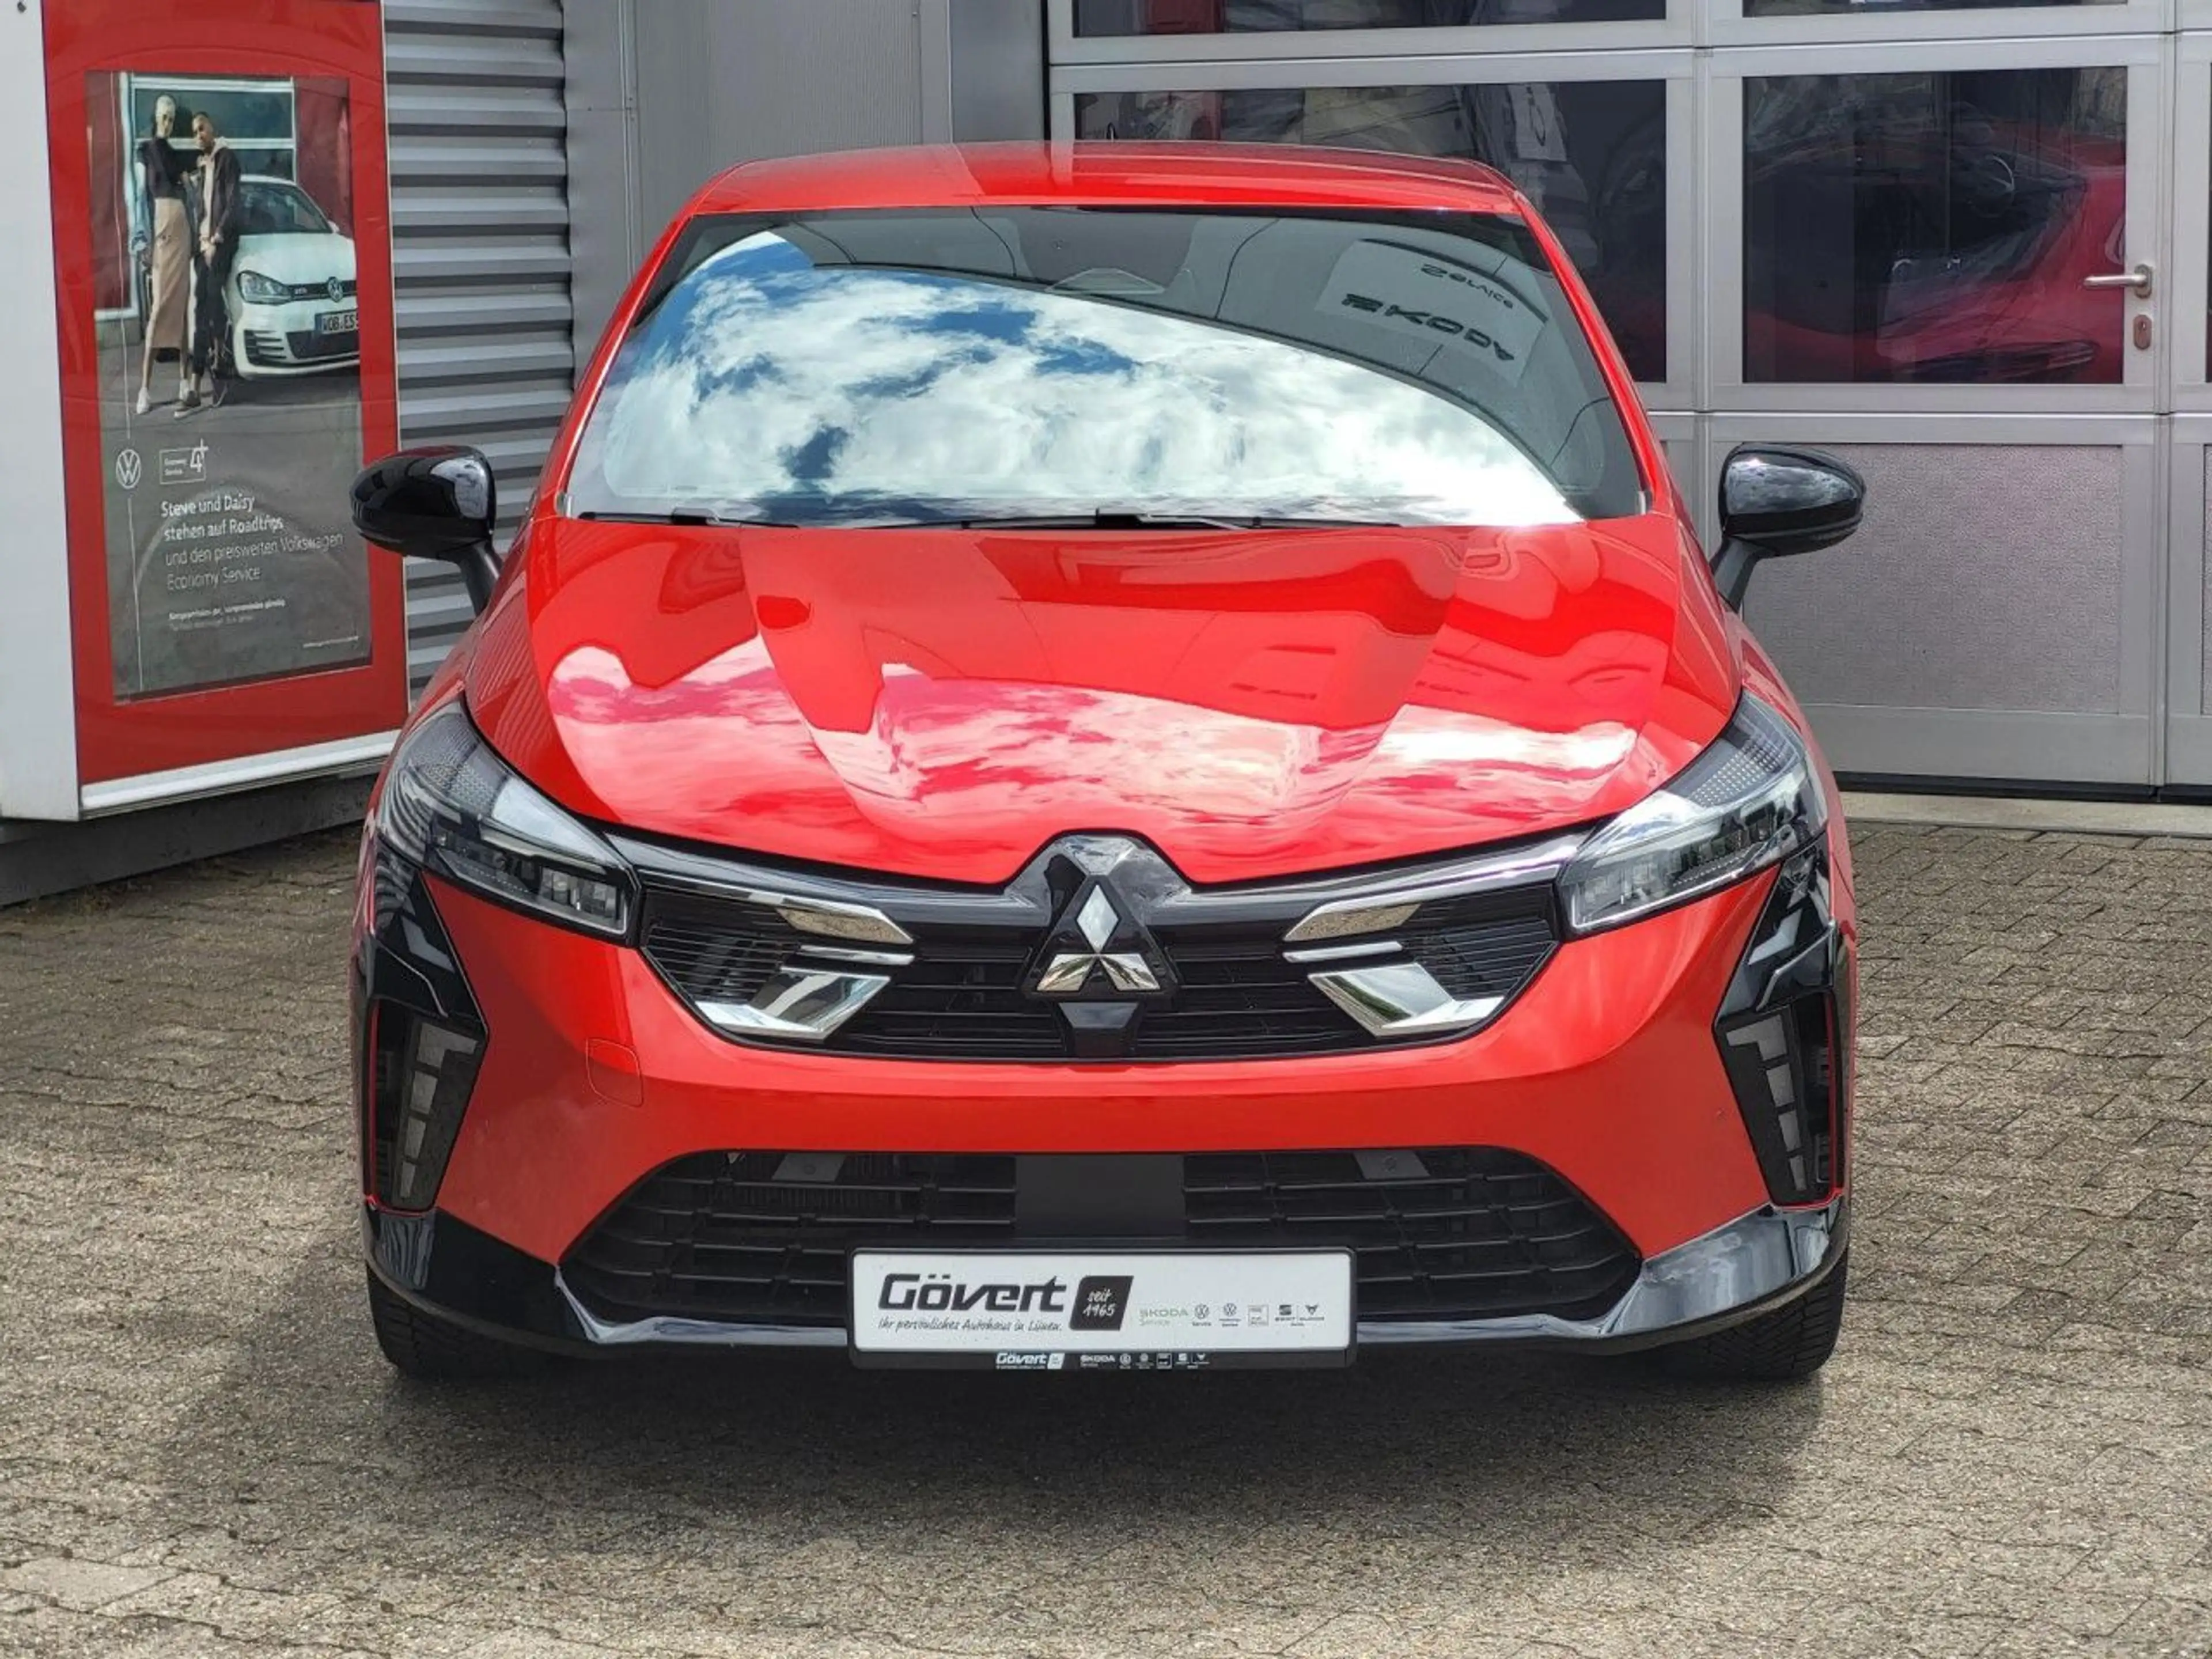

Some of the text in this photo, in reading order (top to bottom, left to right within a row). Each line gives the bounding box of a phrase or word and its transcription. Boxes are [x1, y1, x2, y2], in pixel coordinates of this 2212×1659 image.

[161, 493, 255, 517] Steve und Daisy
[164, 522, 205, 541] stehen
[207, 519, 226, 536] auf
[165, 549, 188, 566] und
[190, 547, 212, 563] den
[280, 534, 343, 553] Volkswagen
[166, 566, 261, 590] Economy Service
[878, 1274, 1067, 1312] Gövert
[1087, 1288, 1112, 1302] seit
[1083, 1303, 1116, 1317] 1965
